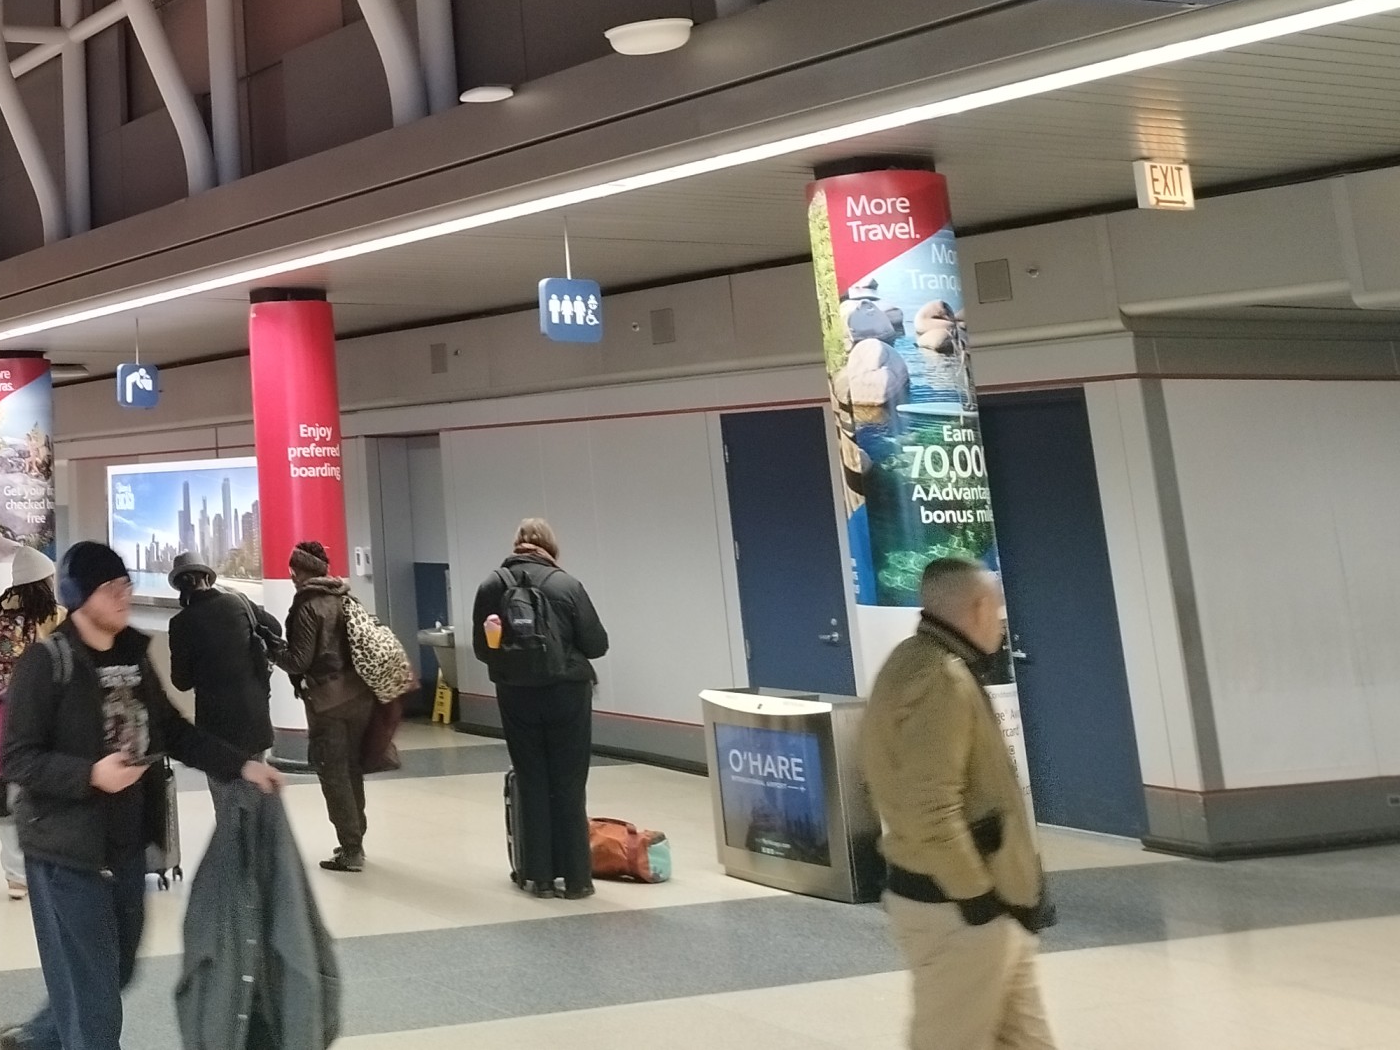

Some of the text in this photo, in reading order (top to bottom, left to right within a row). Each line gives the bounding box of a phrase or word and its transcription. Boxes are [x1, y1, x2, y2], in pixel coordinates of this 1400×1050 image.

[1149, 164, 1184, 197] EXIT
[846, 194, 911, 218] More
[845, 216, 921, 243] Travel.
[931, 243, 958, 265] Mo
[905, 268, 962, 296] Tranq
[299, 423, 333, 441] Enjoy
[942, 425, 975, 442] Earn
[287, 443, 340, 461] preferred
[290, 462, 341, 481] boarding
[3, 485, 22, 496] Get
[5, 498, 46, 510] checked
[27, 512, 46, 524] free
[920, 506, 975, 524] bonus
[728, 748, 806, 782] O'HARE
